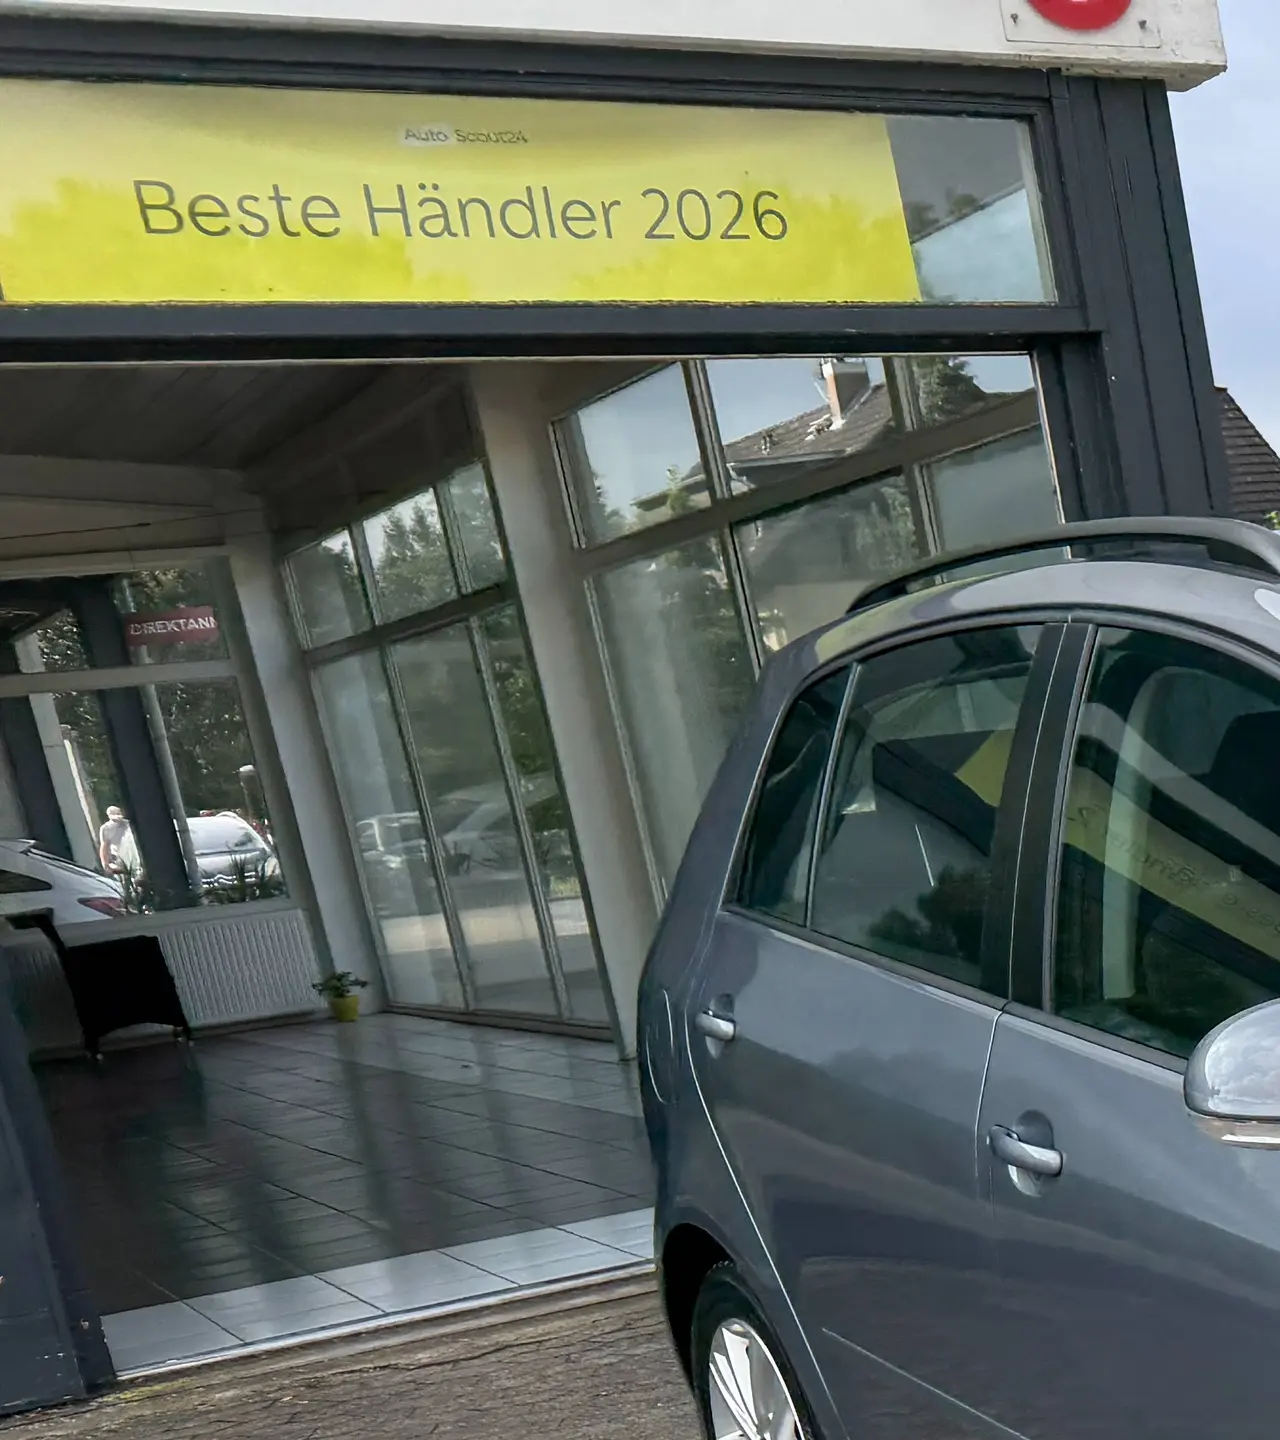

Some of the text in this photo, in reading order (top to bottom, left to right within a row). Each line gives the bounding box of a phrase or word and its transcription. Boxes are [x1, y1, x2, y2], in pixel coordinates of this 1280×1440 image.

[404, 128, 449, 142] Auto
[133, 179, 788, 241] Beste Händler 2026
